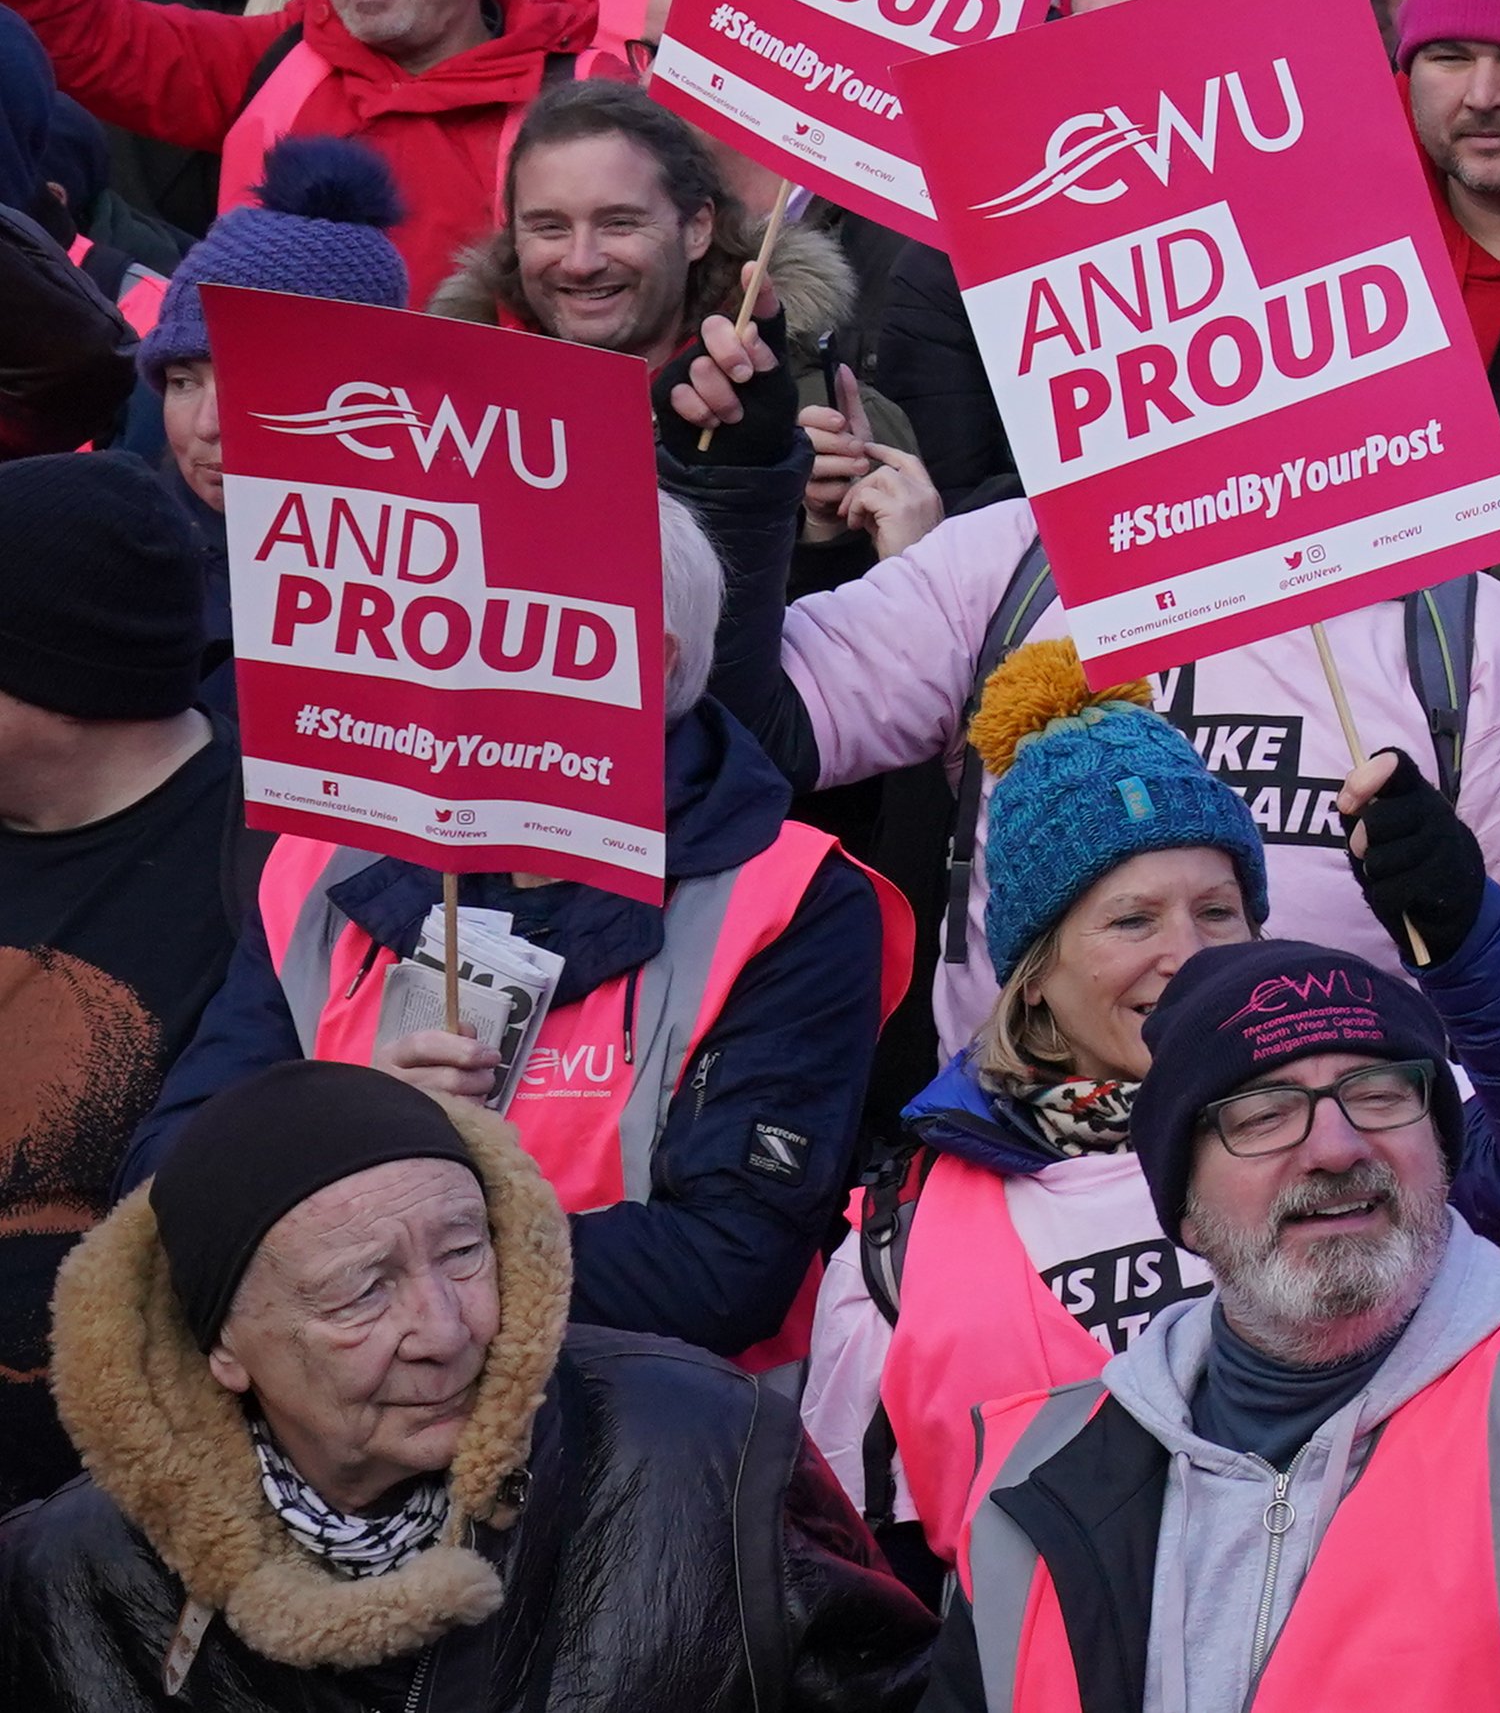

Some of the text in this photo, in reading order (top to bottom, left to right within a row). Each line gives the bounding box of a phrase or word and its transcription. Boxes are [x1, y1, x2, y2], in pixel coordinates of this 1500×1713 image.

[1045, 58, 1305, 206] CWU
[1017, 227, 1226, 378] AND
[1050, 264, 1409, 463] PROUD
[328, 381, 569, 490] CWU
[1108, 418, 1445, 553] #StandByYourPost
[254, 492, 460, 586] AND
[1371, 524, 1424, 551] #TheCWU
[1278, 562, 1344, 593] @CWUNews
[270, 574, 619, 681] PROUD
[1097, 591, 1247, 648] The Communications Union
[295, 704, 614, 787] #StandByYourPost
[262, 786, 399, 824] The Communications Union
[601, 836, 648, 857] CWU.ORG
[1251, 970, 1372, 1012] CWU
[1253, 1030, 1384, 1060] Amalgamated Branch
[1257, 1017, 1375, 1045] North West Central
[522, 1044, 614, 1085] CWU
